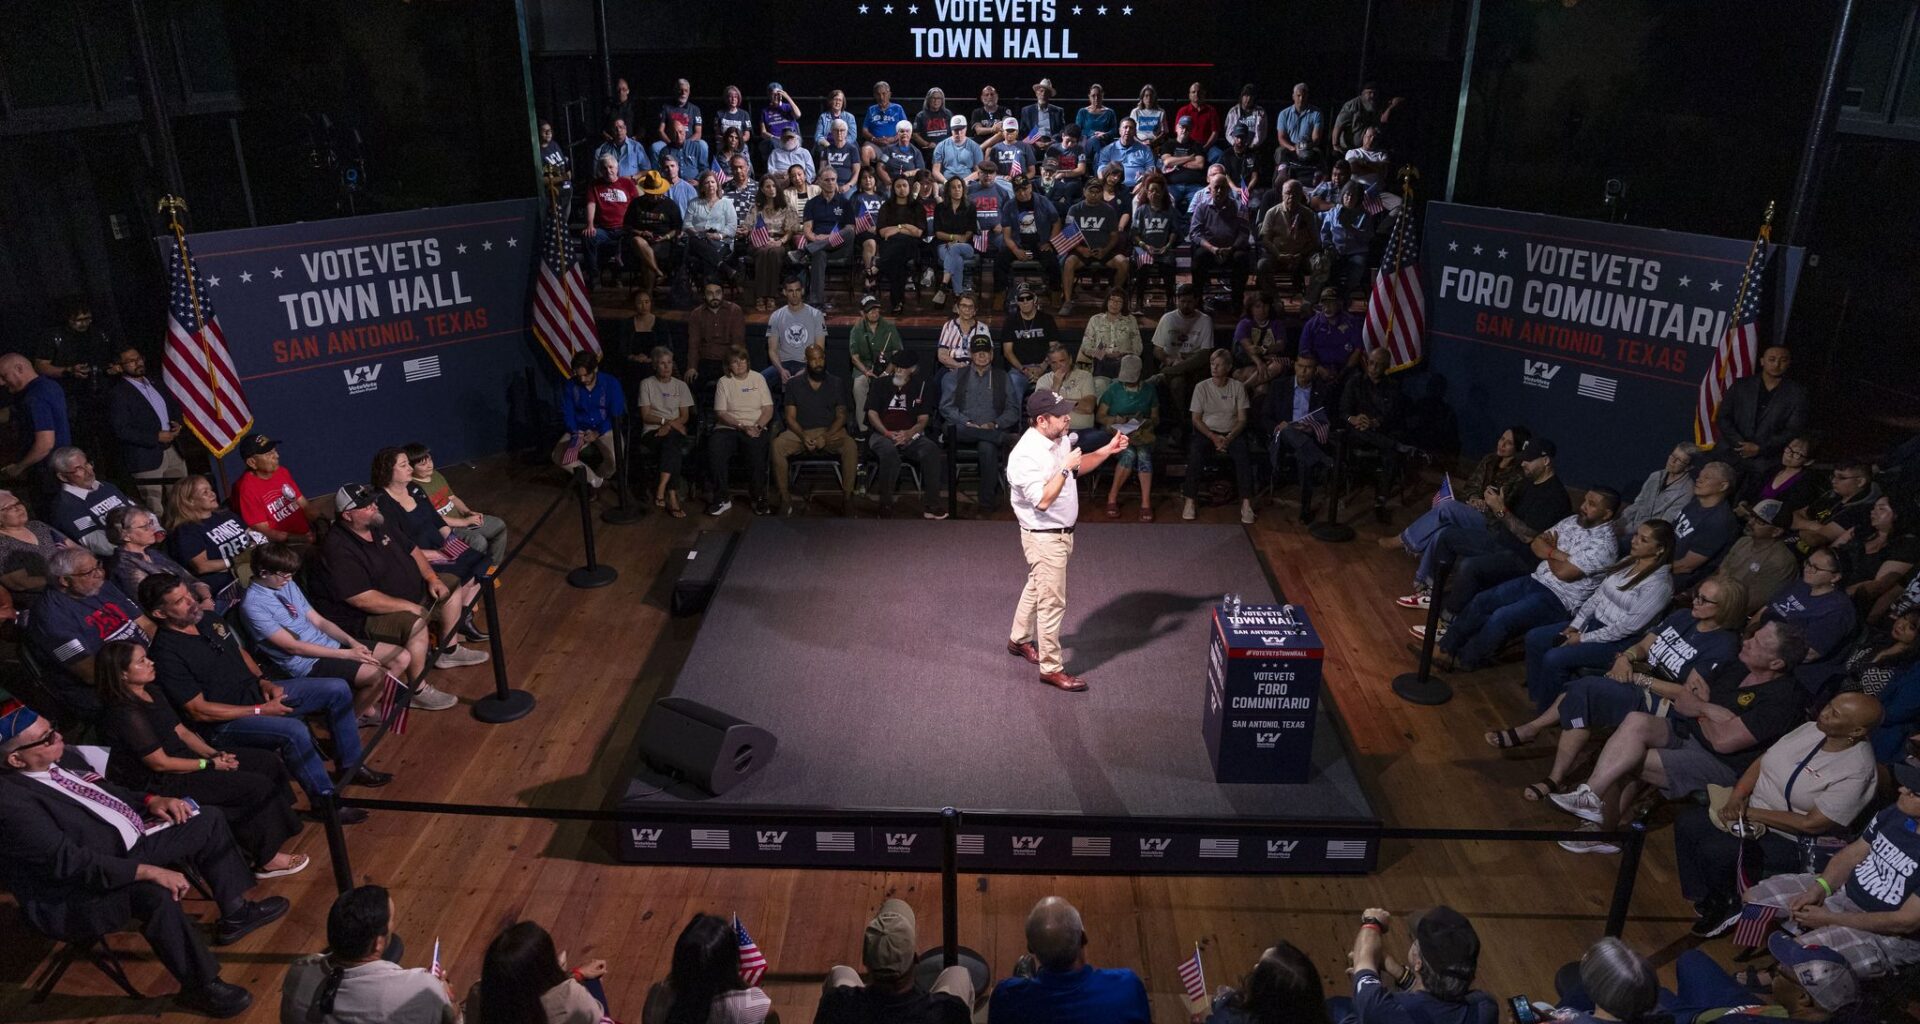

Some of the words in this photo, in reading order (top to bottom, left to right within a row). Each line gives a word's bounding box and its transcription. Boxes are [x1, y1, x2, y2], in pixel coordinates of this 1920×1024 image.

[935, 0, 1056, 22] VOTEVETS
[911, 28, 992, 58] TOWN
[1004, 29, 1078, 59] HALL
[301, 238, 441, 283] VOTEVETS
[1526, 242, 1661, 291] VOTEVETS
[279, 283, 380, 330] TOWN
[388, 271, 472, 312] HALL
[1439, 266, 1514, 309] FORO
[1522, 280, 1728, 348] COMUNITARI
[273, 335, 320, 363] SAN
[327, 323, 420, 355] ANTONIO,
[425, 308, 488, 338] TEXAS
[1475, 312, 1513, 337] SAN
[1519, 316, 1606, 359] ANTONIO,
[1617, 338, 1688, 373] TEXAS
[1227, 616, 1265, 625] TOWN
[1253, 672, 1295, 681] VOTEVETS
[1257, 683, 1288, 695] FORO
[1232, 697, 1310, 709] COMUNITARIO
[1232, 720, 1247, 728] SAN
[1248, 721, 1280, 729] ANTONIO,
[1282, 721, 1305, 729] TEXAS
